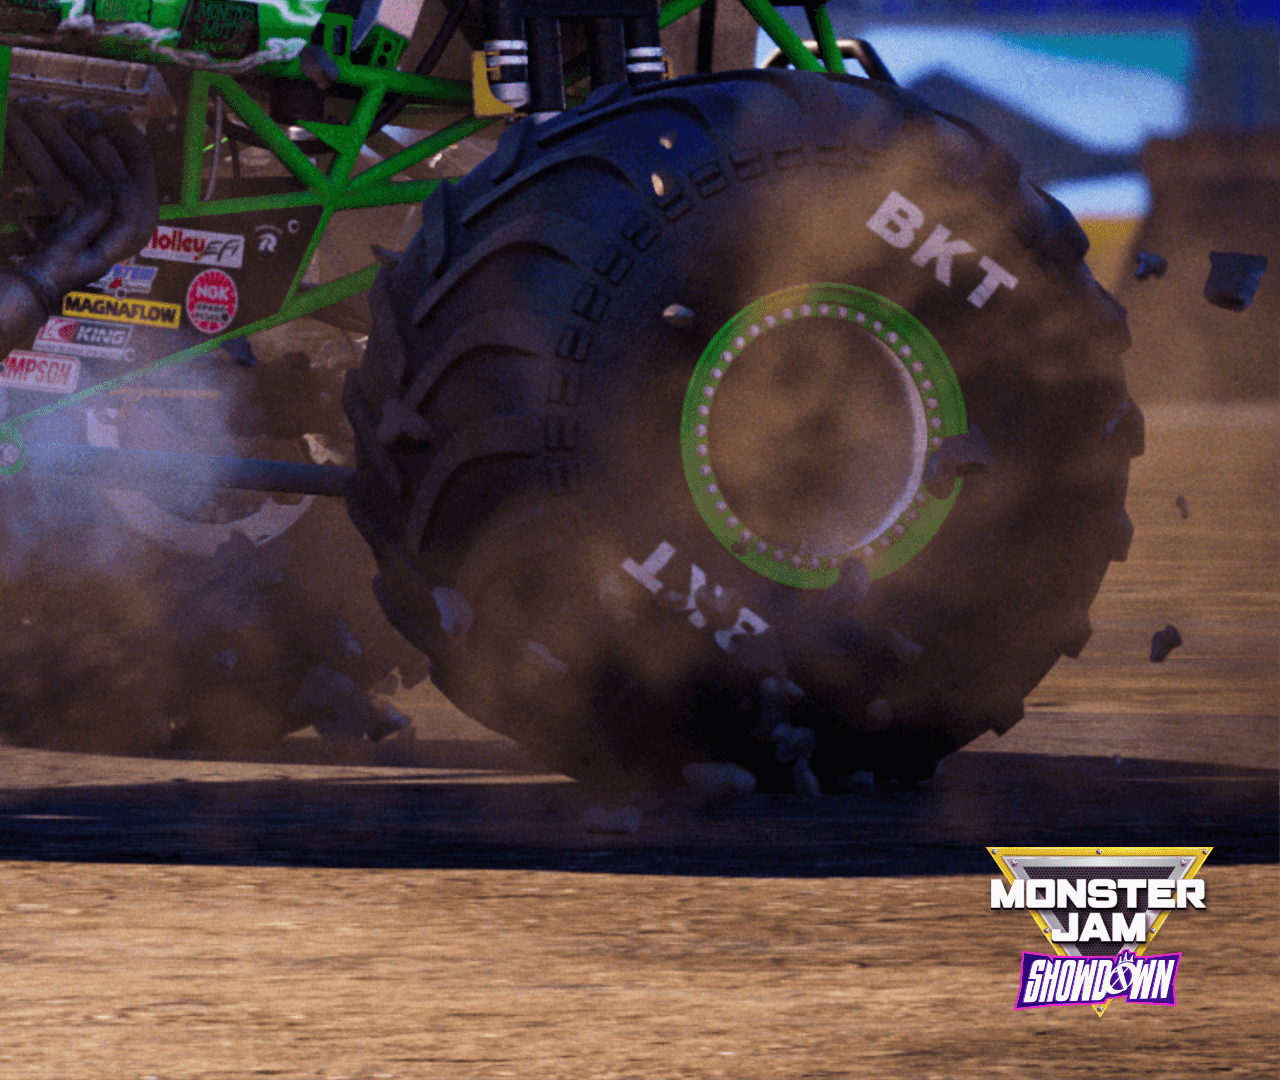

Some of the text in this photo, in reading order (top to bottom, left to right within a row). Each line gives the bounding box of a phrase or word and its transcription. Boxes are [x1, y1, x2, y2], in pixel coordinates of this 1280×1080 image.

[865, 190, 1019, 309] BKT
[195, 284, 230, 302] NGK
[65, 296, 177, 324] MAGNAFLOW
[76, 324, 128, 345] KING
